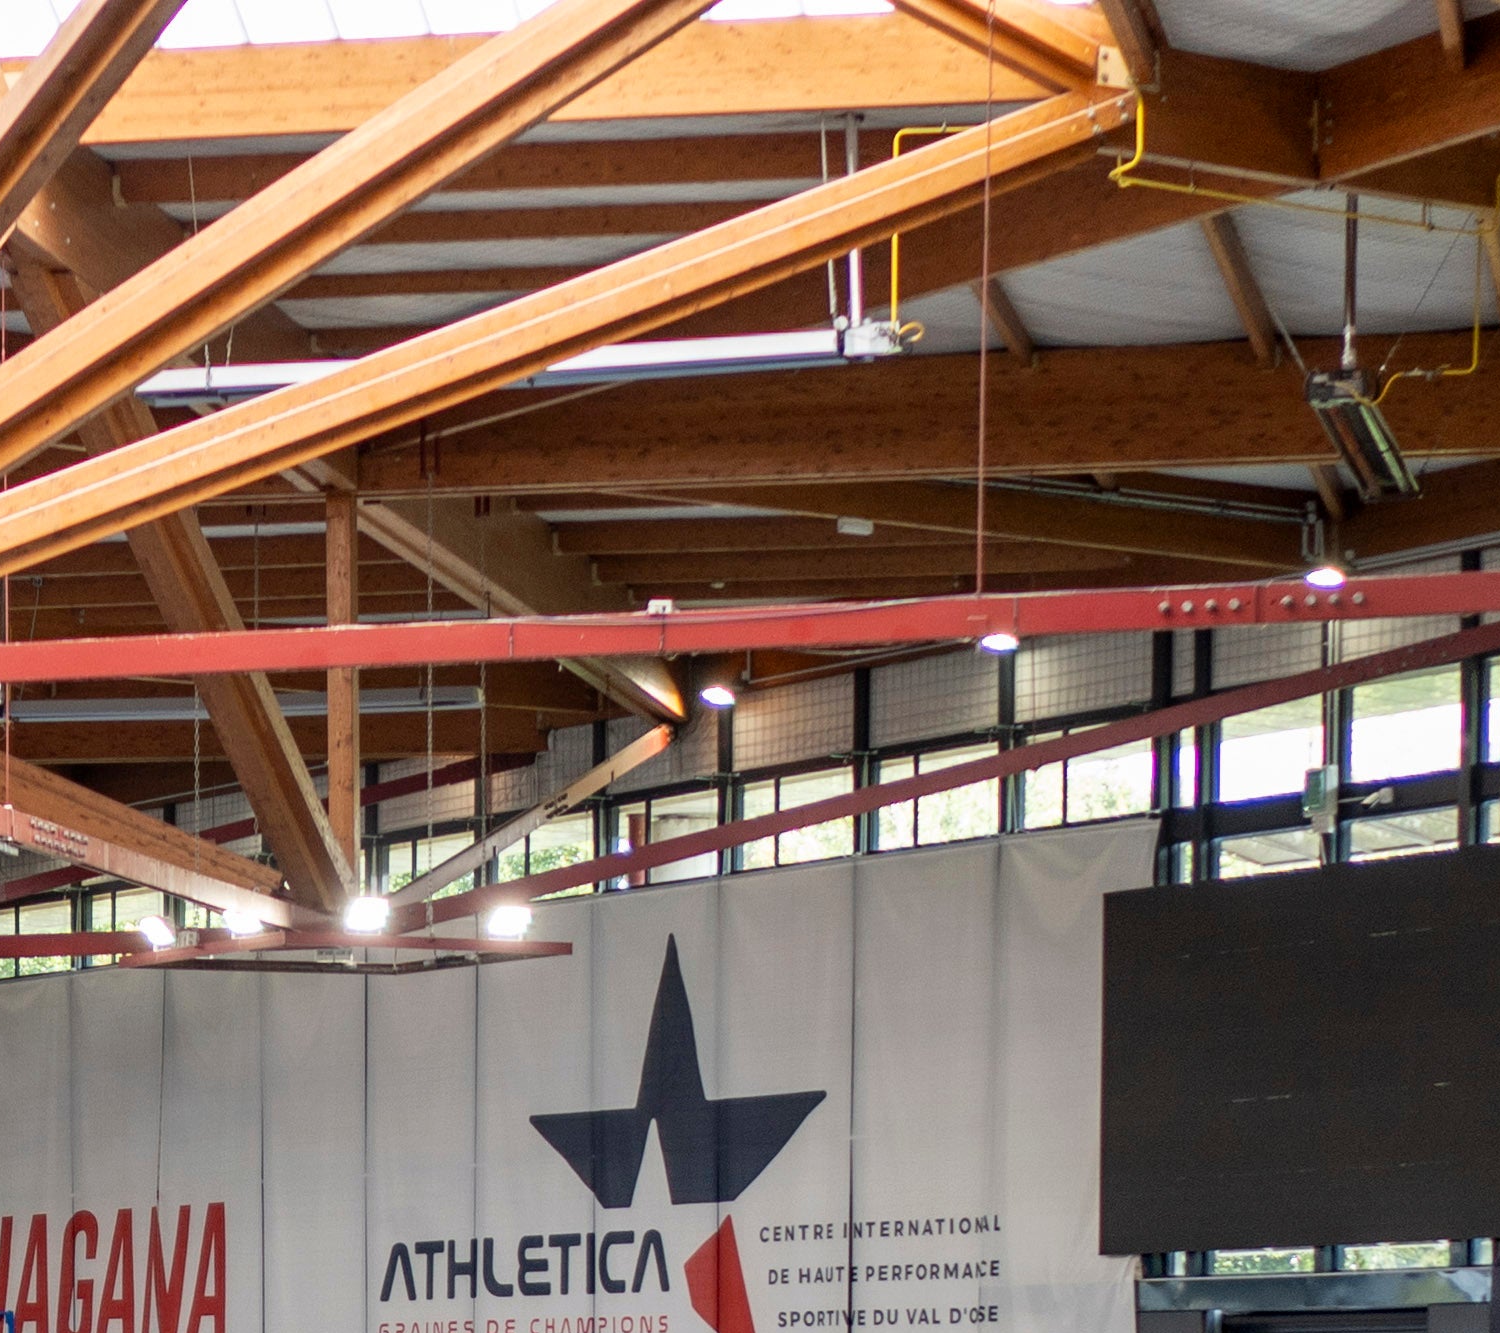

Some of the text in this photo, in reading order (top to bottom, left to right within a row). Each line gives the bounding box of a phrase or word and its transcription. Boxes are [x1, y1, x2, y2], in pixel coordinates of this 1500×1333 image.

[760, 1223, 834, 1243] CENTRE
[380, 1229, 670, 1302] ATHLETICA
[769, 1269, 790, 1285] DE
[799, 1266, 859, 1284] HAUTE
[778, 1309, 866, 1327] SPORTIVE
[874, 1309, 899, 1326] DU
[907, 1308, 941, 1325] VAL
